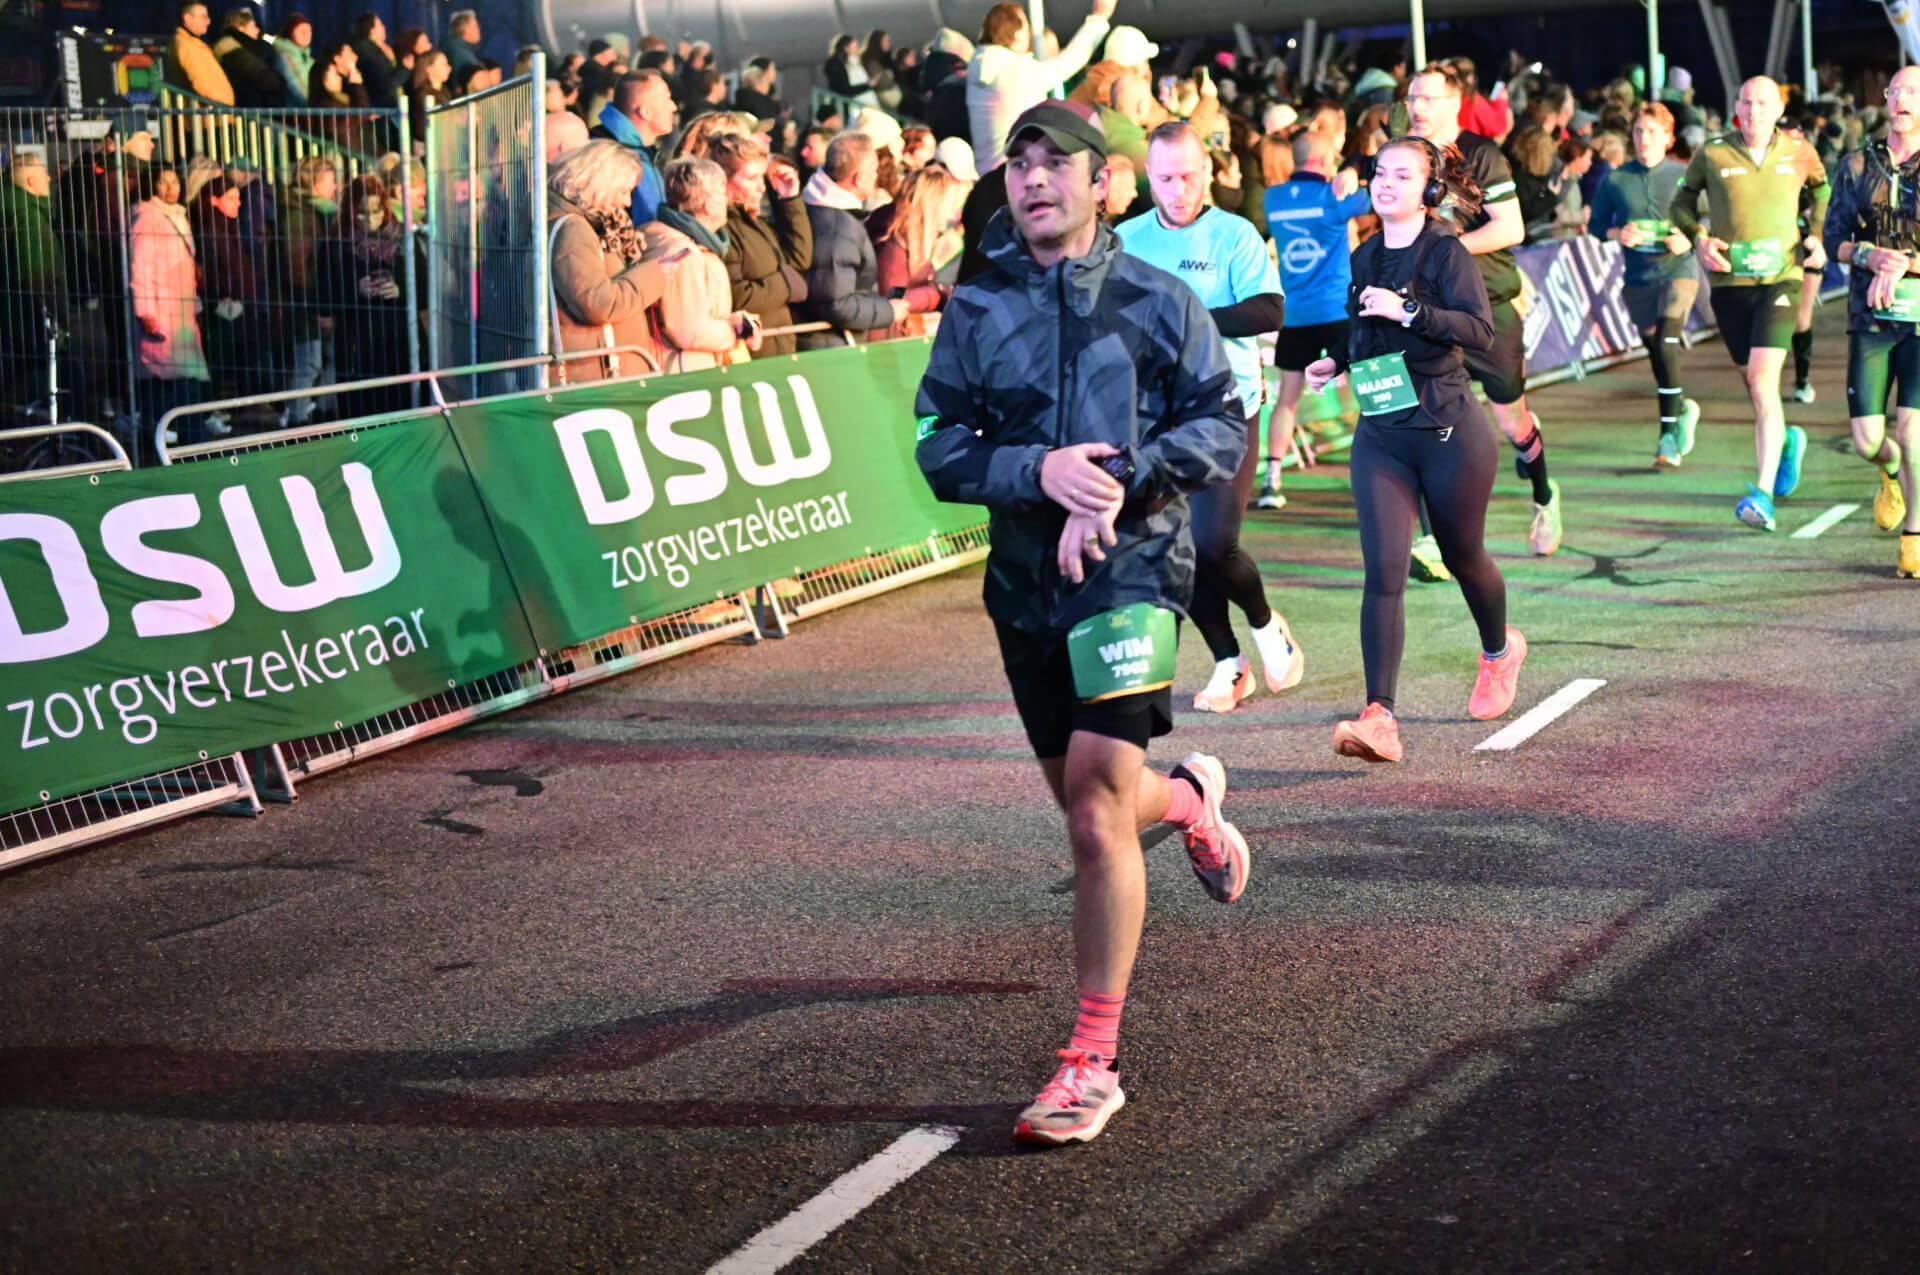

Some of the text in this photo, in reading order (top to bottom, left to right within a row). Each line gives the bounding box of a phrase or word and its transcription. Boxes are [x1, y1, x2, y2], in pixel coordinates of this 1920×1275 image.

[1357, 374, 1405, 396] MAAIKE
[552, 374, 832, 525] DSW
[0, 462, 402, 664] DSW
[602, 491, 853, 589] zorgverzekeraar
[7, 607, 430, 750] zorgverzekeraar
[1098, 635, 1154, 665] WIM
